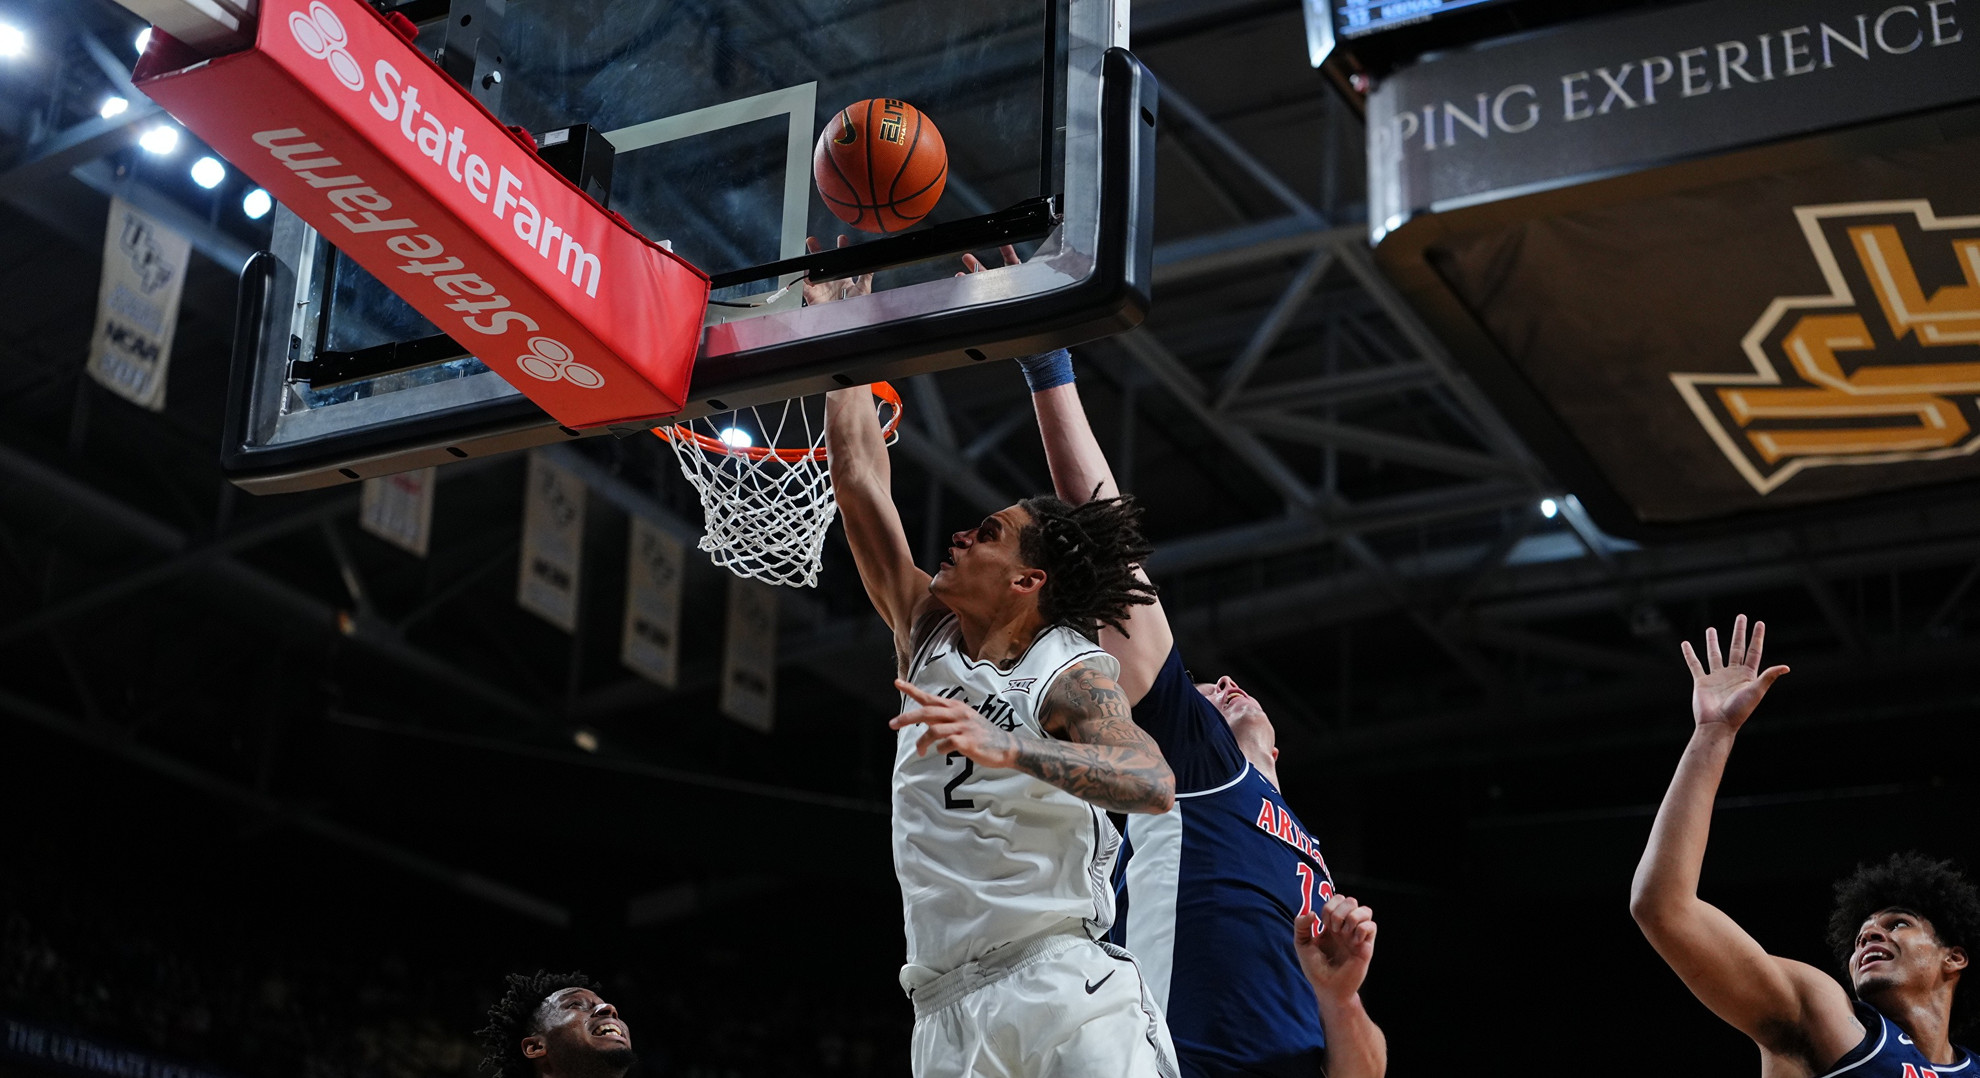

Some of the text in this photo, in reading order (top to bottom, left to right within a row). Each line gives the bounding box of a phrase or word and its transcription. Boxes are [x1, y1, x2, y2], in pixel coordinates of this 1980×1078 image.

[1561, 0, 1963, 121] EXPERIENCE
[879, 98, 904, 144] ELITE
[945, 751, 975, 809] 2
